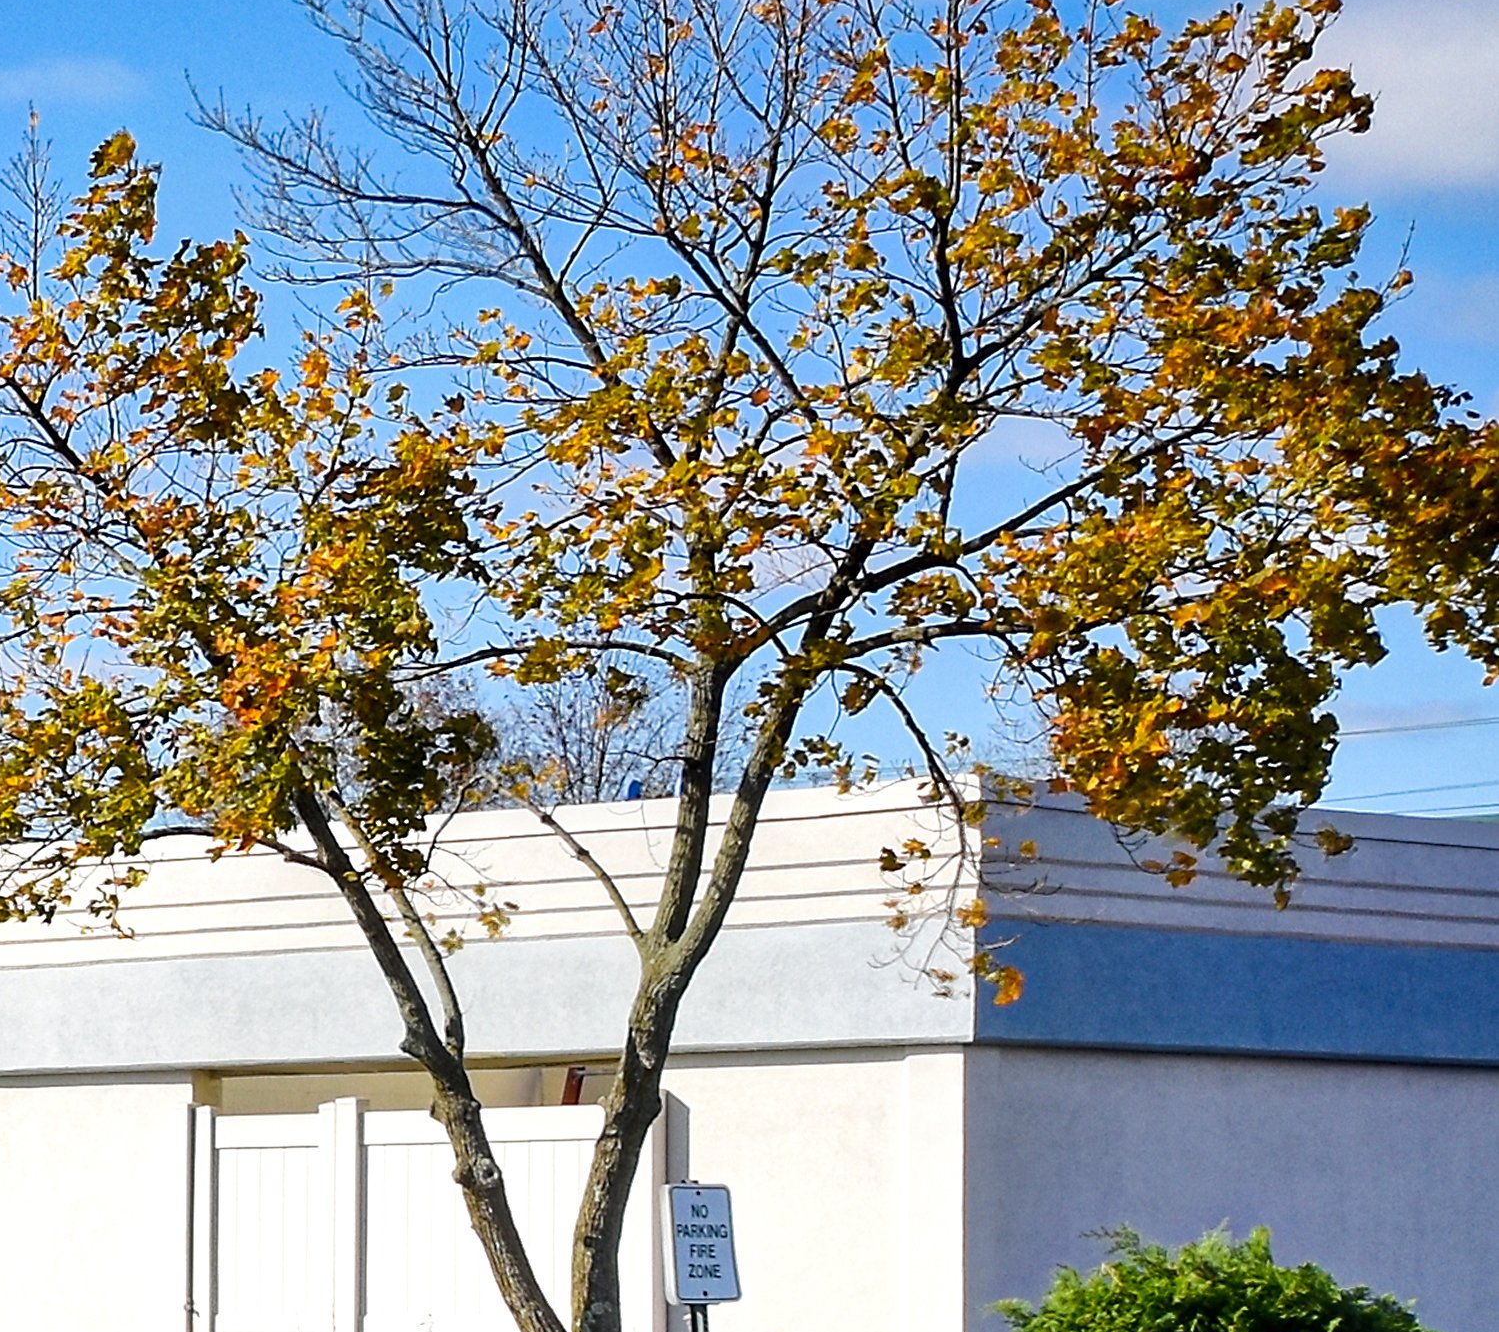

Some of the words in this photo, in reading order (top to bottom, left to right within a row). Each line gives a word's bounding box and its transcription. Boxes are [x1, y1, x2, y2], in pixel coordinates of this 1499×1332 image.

[691, 1204, 709, 1218] NO
[676, 1224, 728, 1238] PARKING
[689, 1244, 716, 1258] FIRE
[688, 1264, 722, 1278] ZONE
